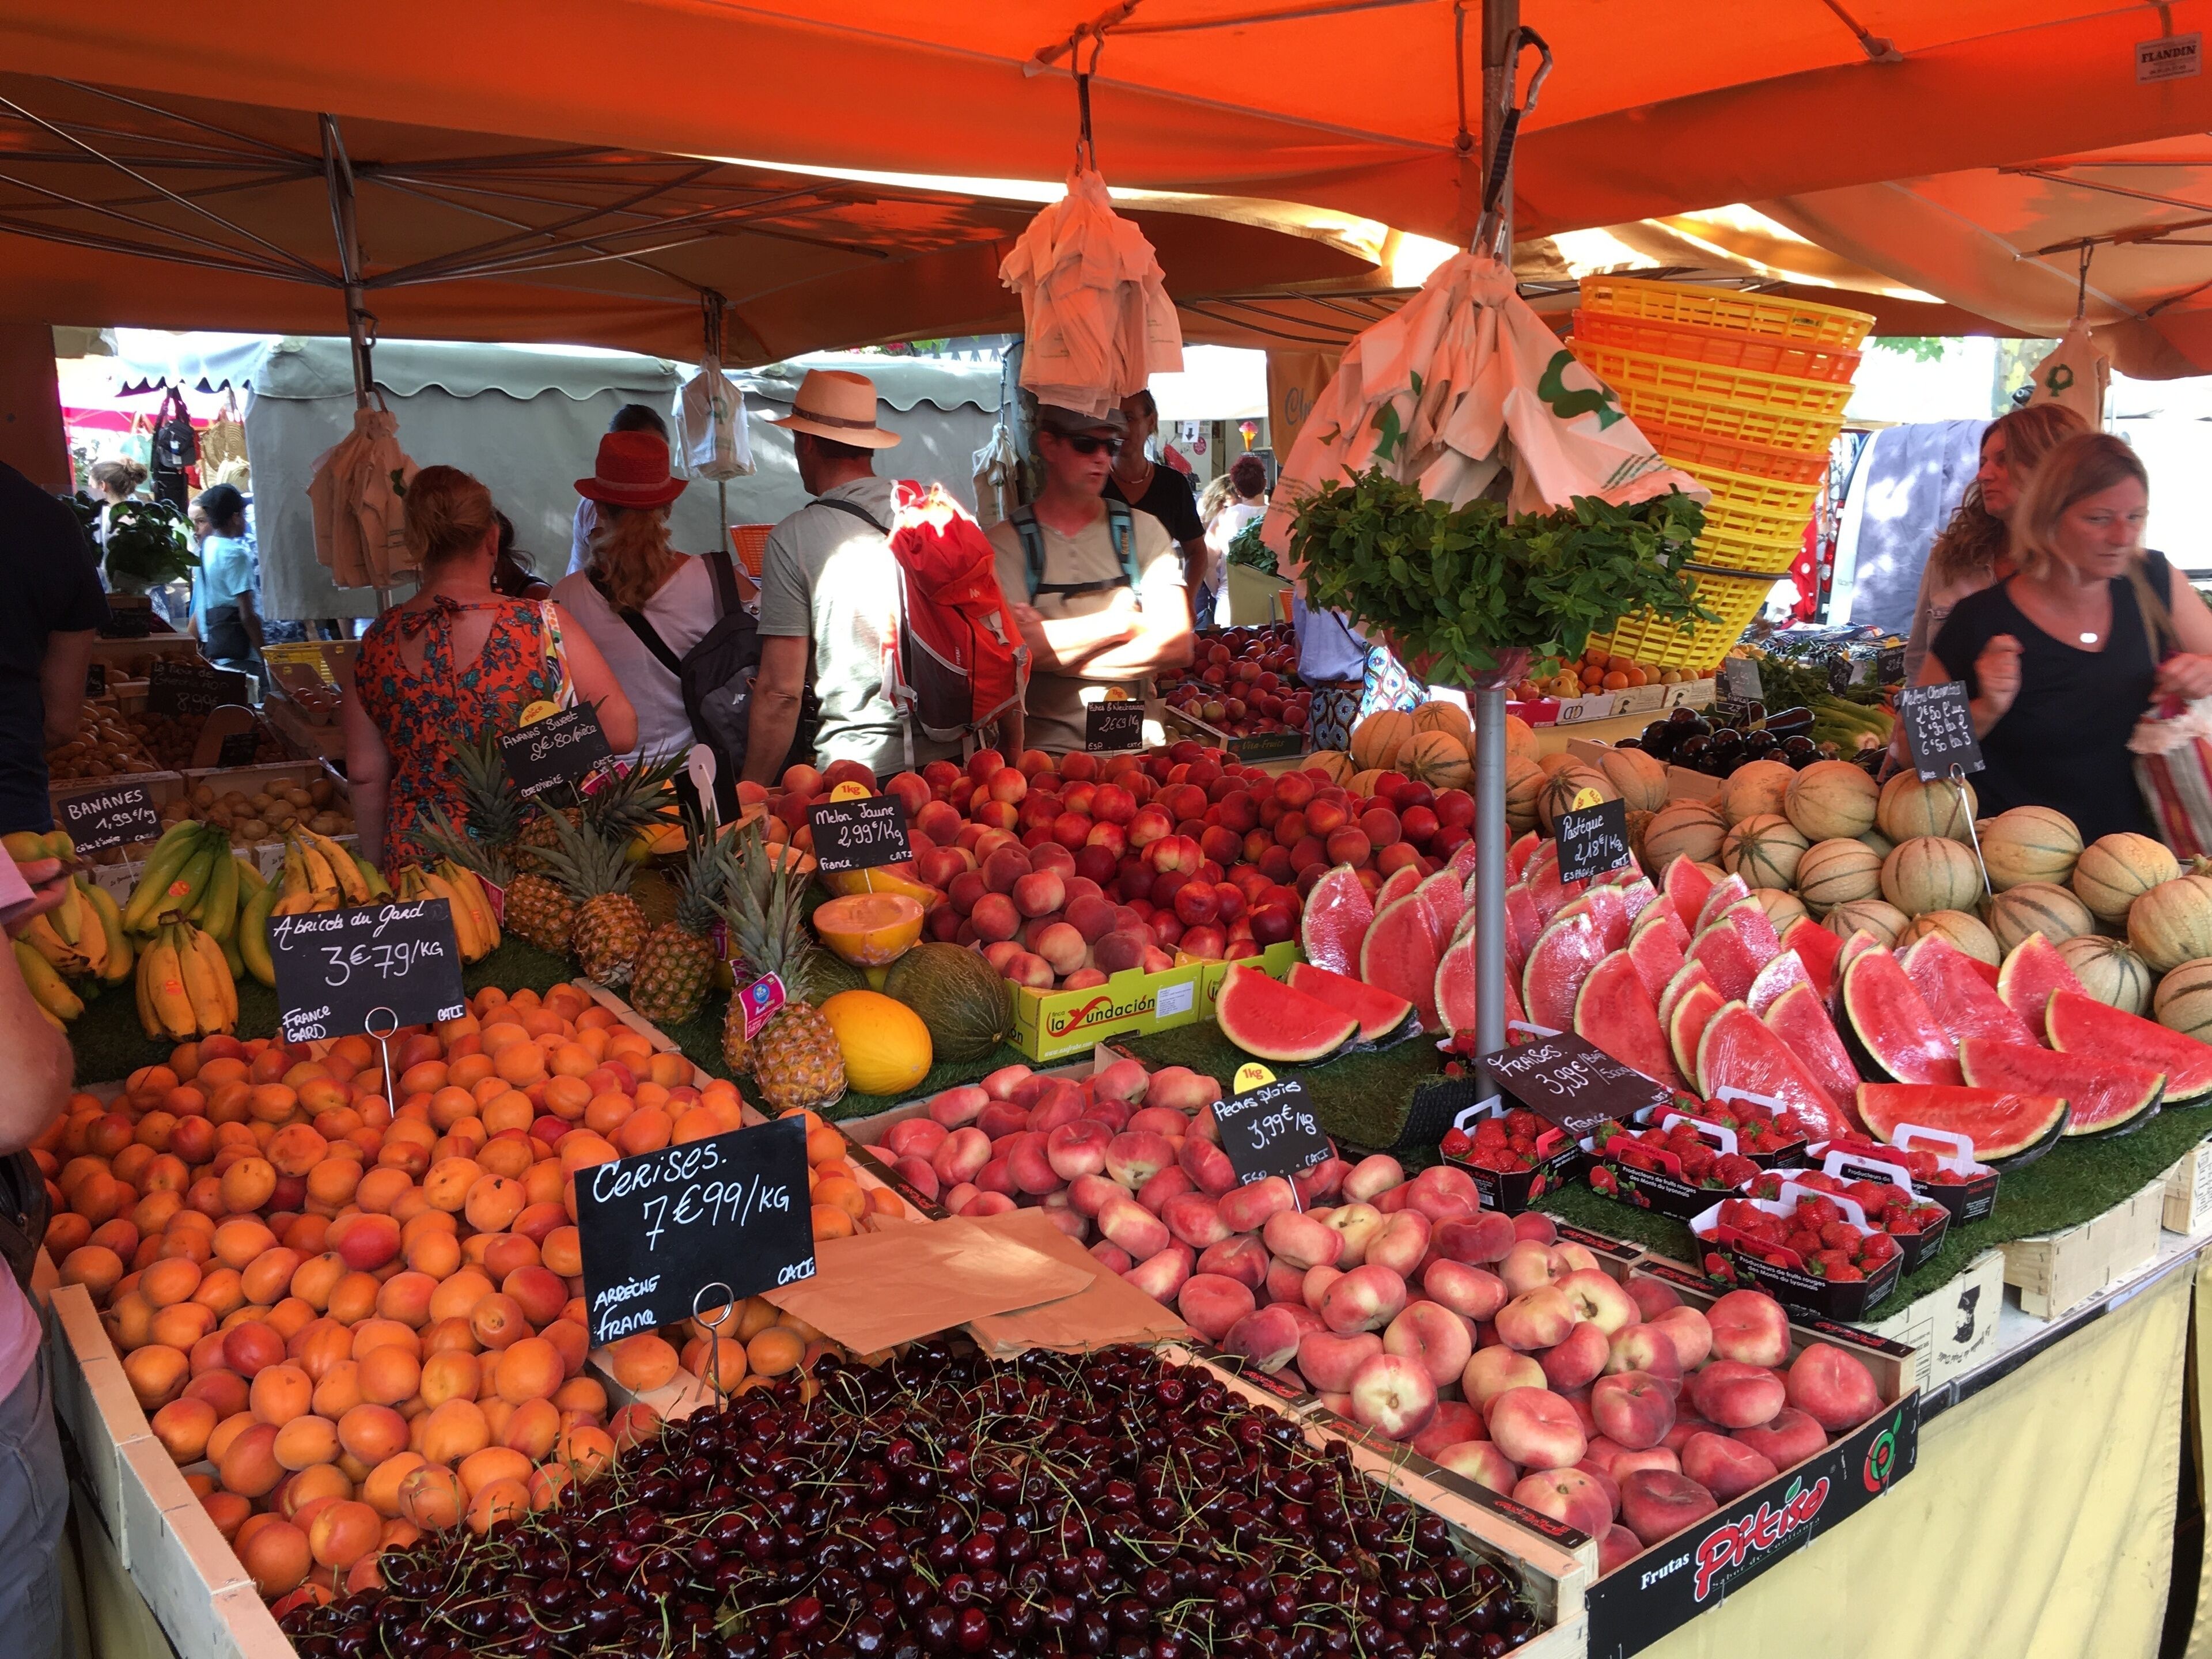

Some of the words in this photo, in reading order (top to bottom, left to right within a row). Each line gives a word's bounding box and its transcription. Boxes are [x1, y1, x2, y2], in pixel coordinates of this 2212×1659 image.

[2141, 45, 2196, 63] FLANDIN
[1963, 732, 1971, 745] 3
[841, 785, 861, 796] 1kg
[67, 789, 143, 820] BANANES
[816, 809, 853, 825] Melon
[857, 802, 895, 819] Jaune
[350, 912, 372, 926] du
[1051, 1010, 1066, 1018] finca
[286, 1023, 327, 1043] GARD
[1242, 1069, 1264, 1080] 1kg
[1640, 1552, 1690, 1590] Frutas
[1694, 1476, 1830, 1603] Pitiso
[1749, 1554, 1763, 1566] de
